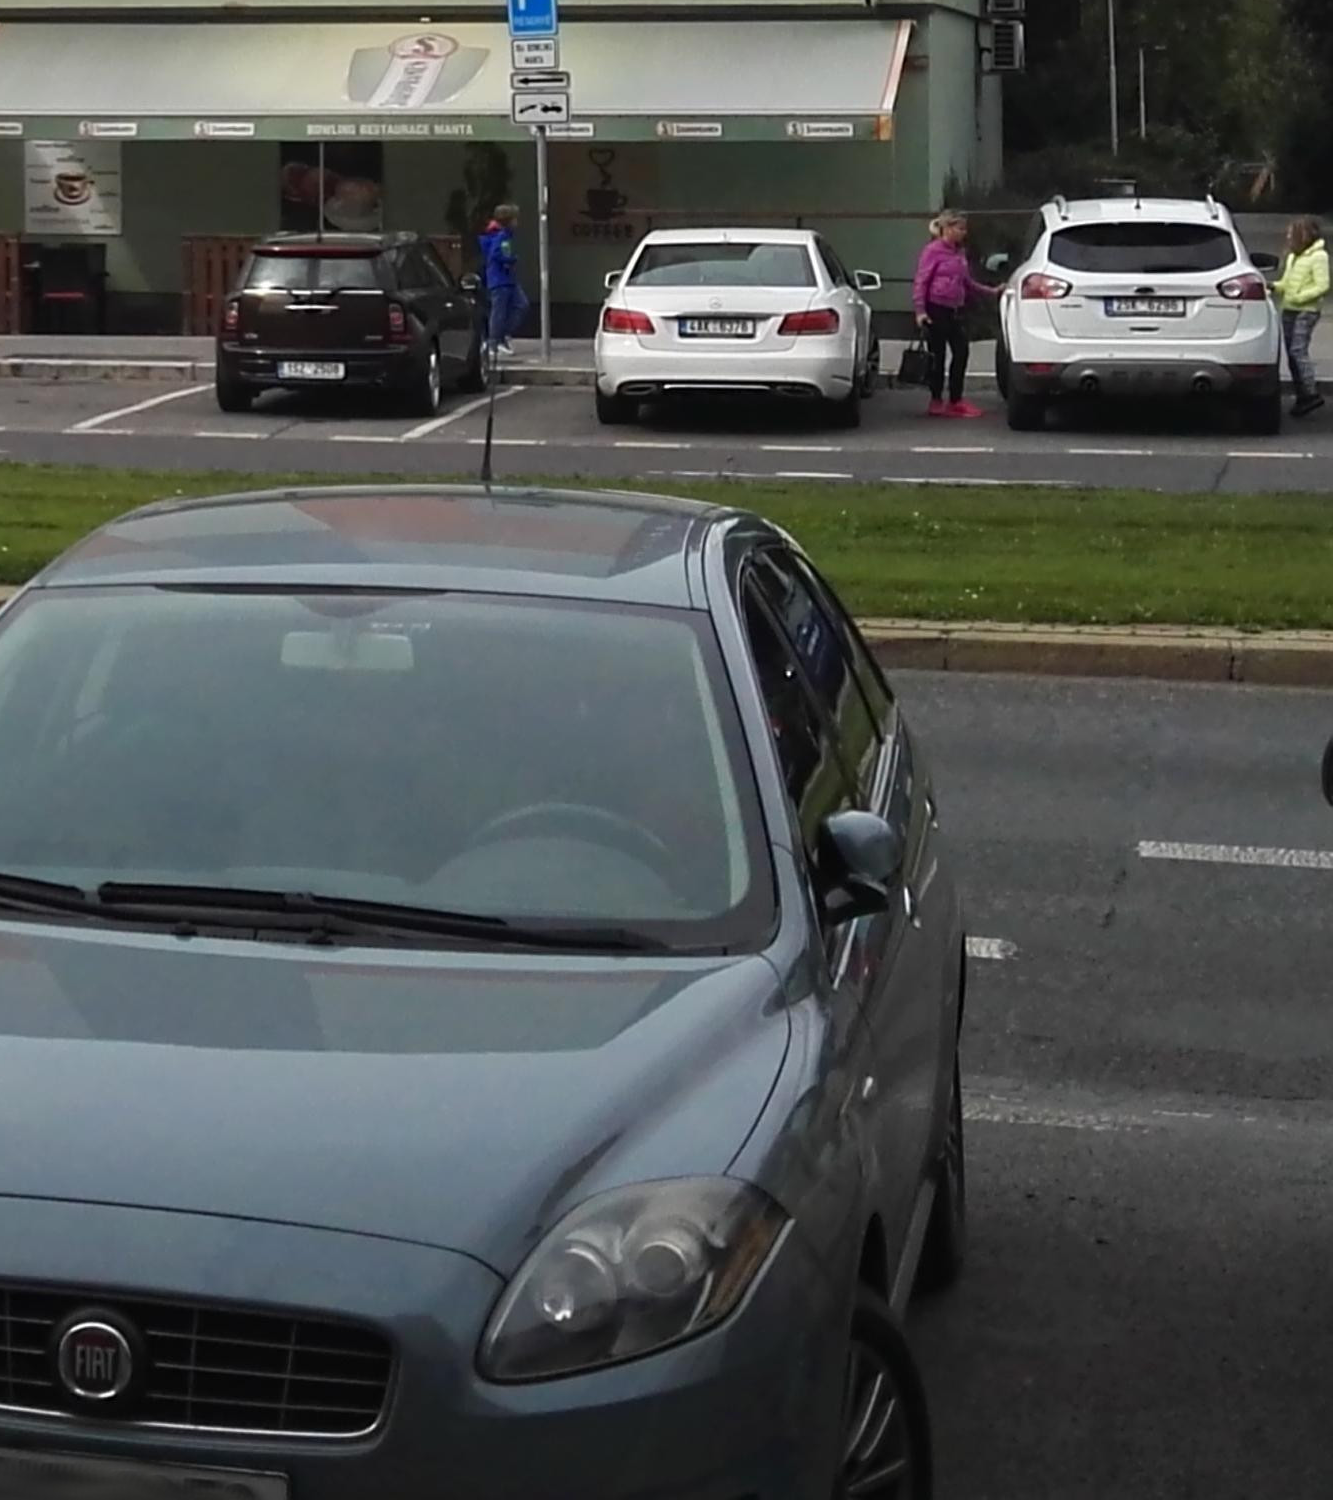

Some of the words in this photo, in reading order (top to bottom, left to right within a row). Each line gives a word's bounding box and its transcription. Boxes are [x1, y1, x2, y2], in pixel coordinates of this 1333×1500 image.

[307, 124, 357, 136] BOWLING
[359, 124, 431, 136] RESTAURACE
[434, 124, 474, 136] MANTA
[75, 1345, 116, 1381] FIAT
